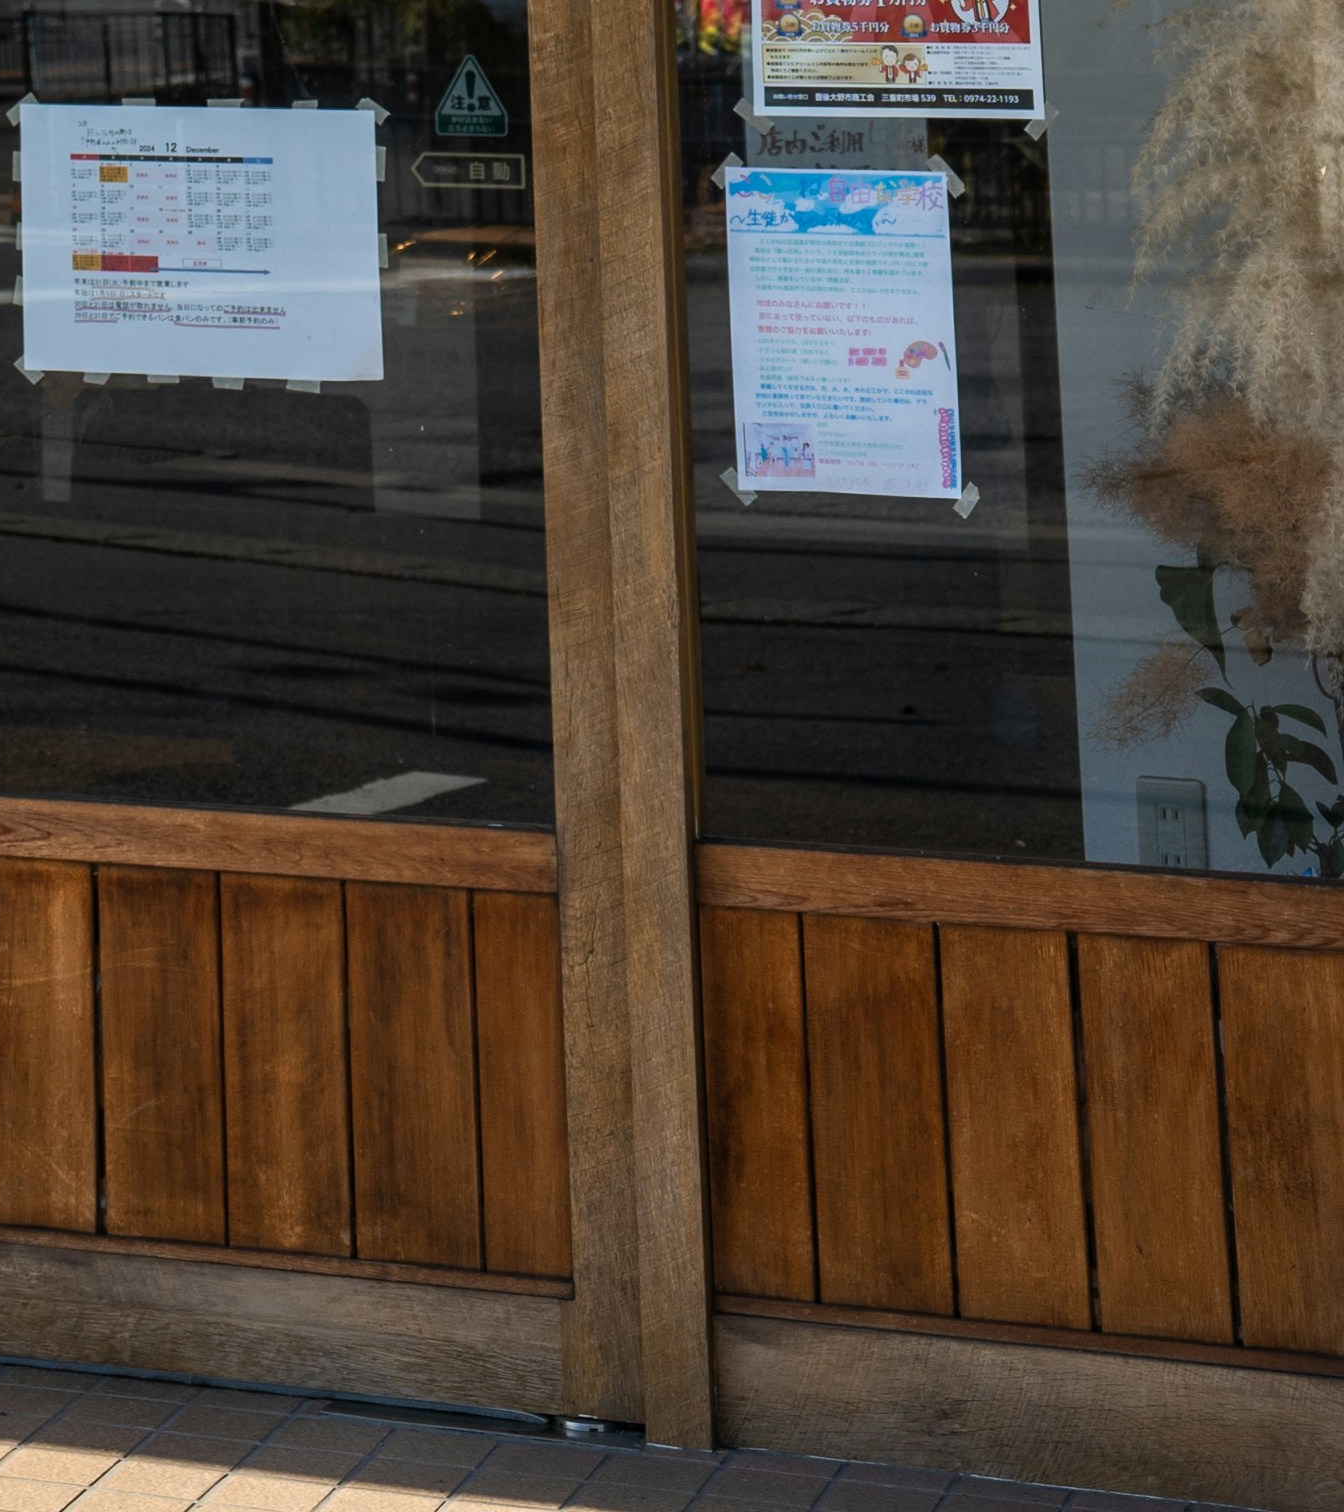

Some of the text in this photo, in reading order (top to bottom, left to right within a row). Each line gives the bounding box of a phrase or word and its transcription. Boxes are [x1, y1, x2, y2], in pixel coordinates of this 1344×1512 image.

[451, 94, 492, 111] 注意
[165, 143, 178, 153] 12
[186, 146, 220, 155] December
[470, 161, 511, 181] 自動
